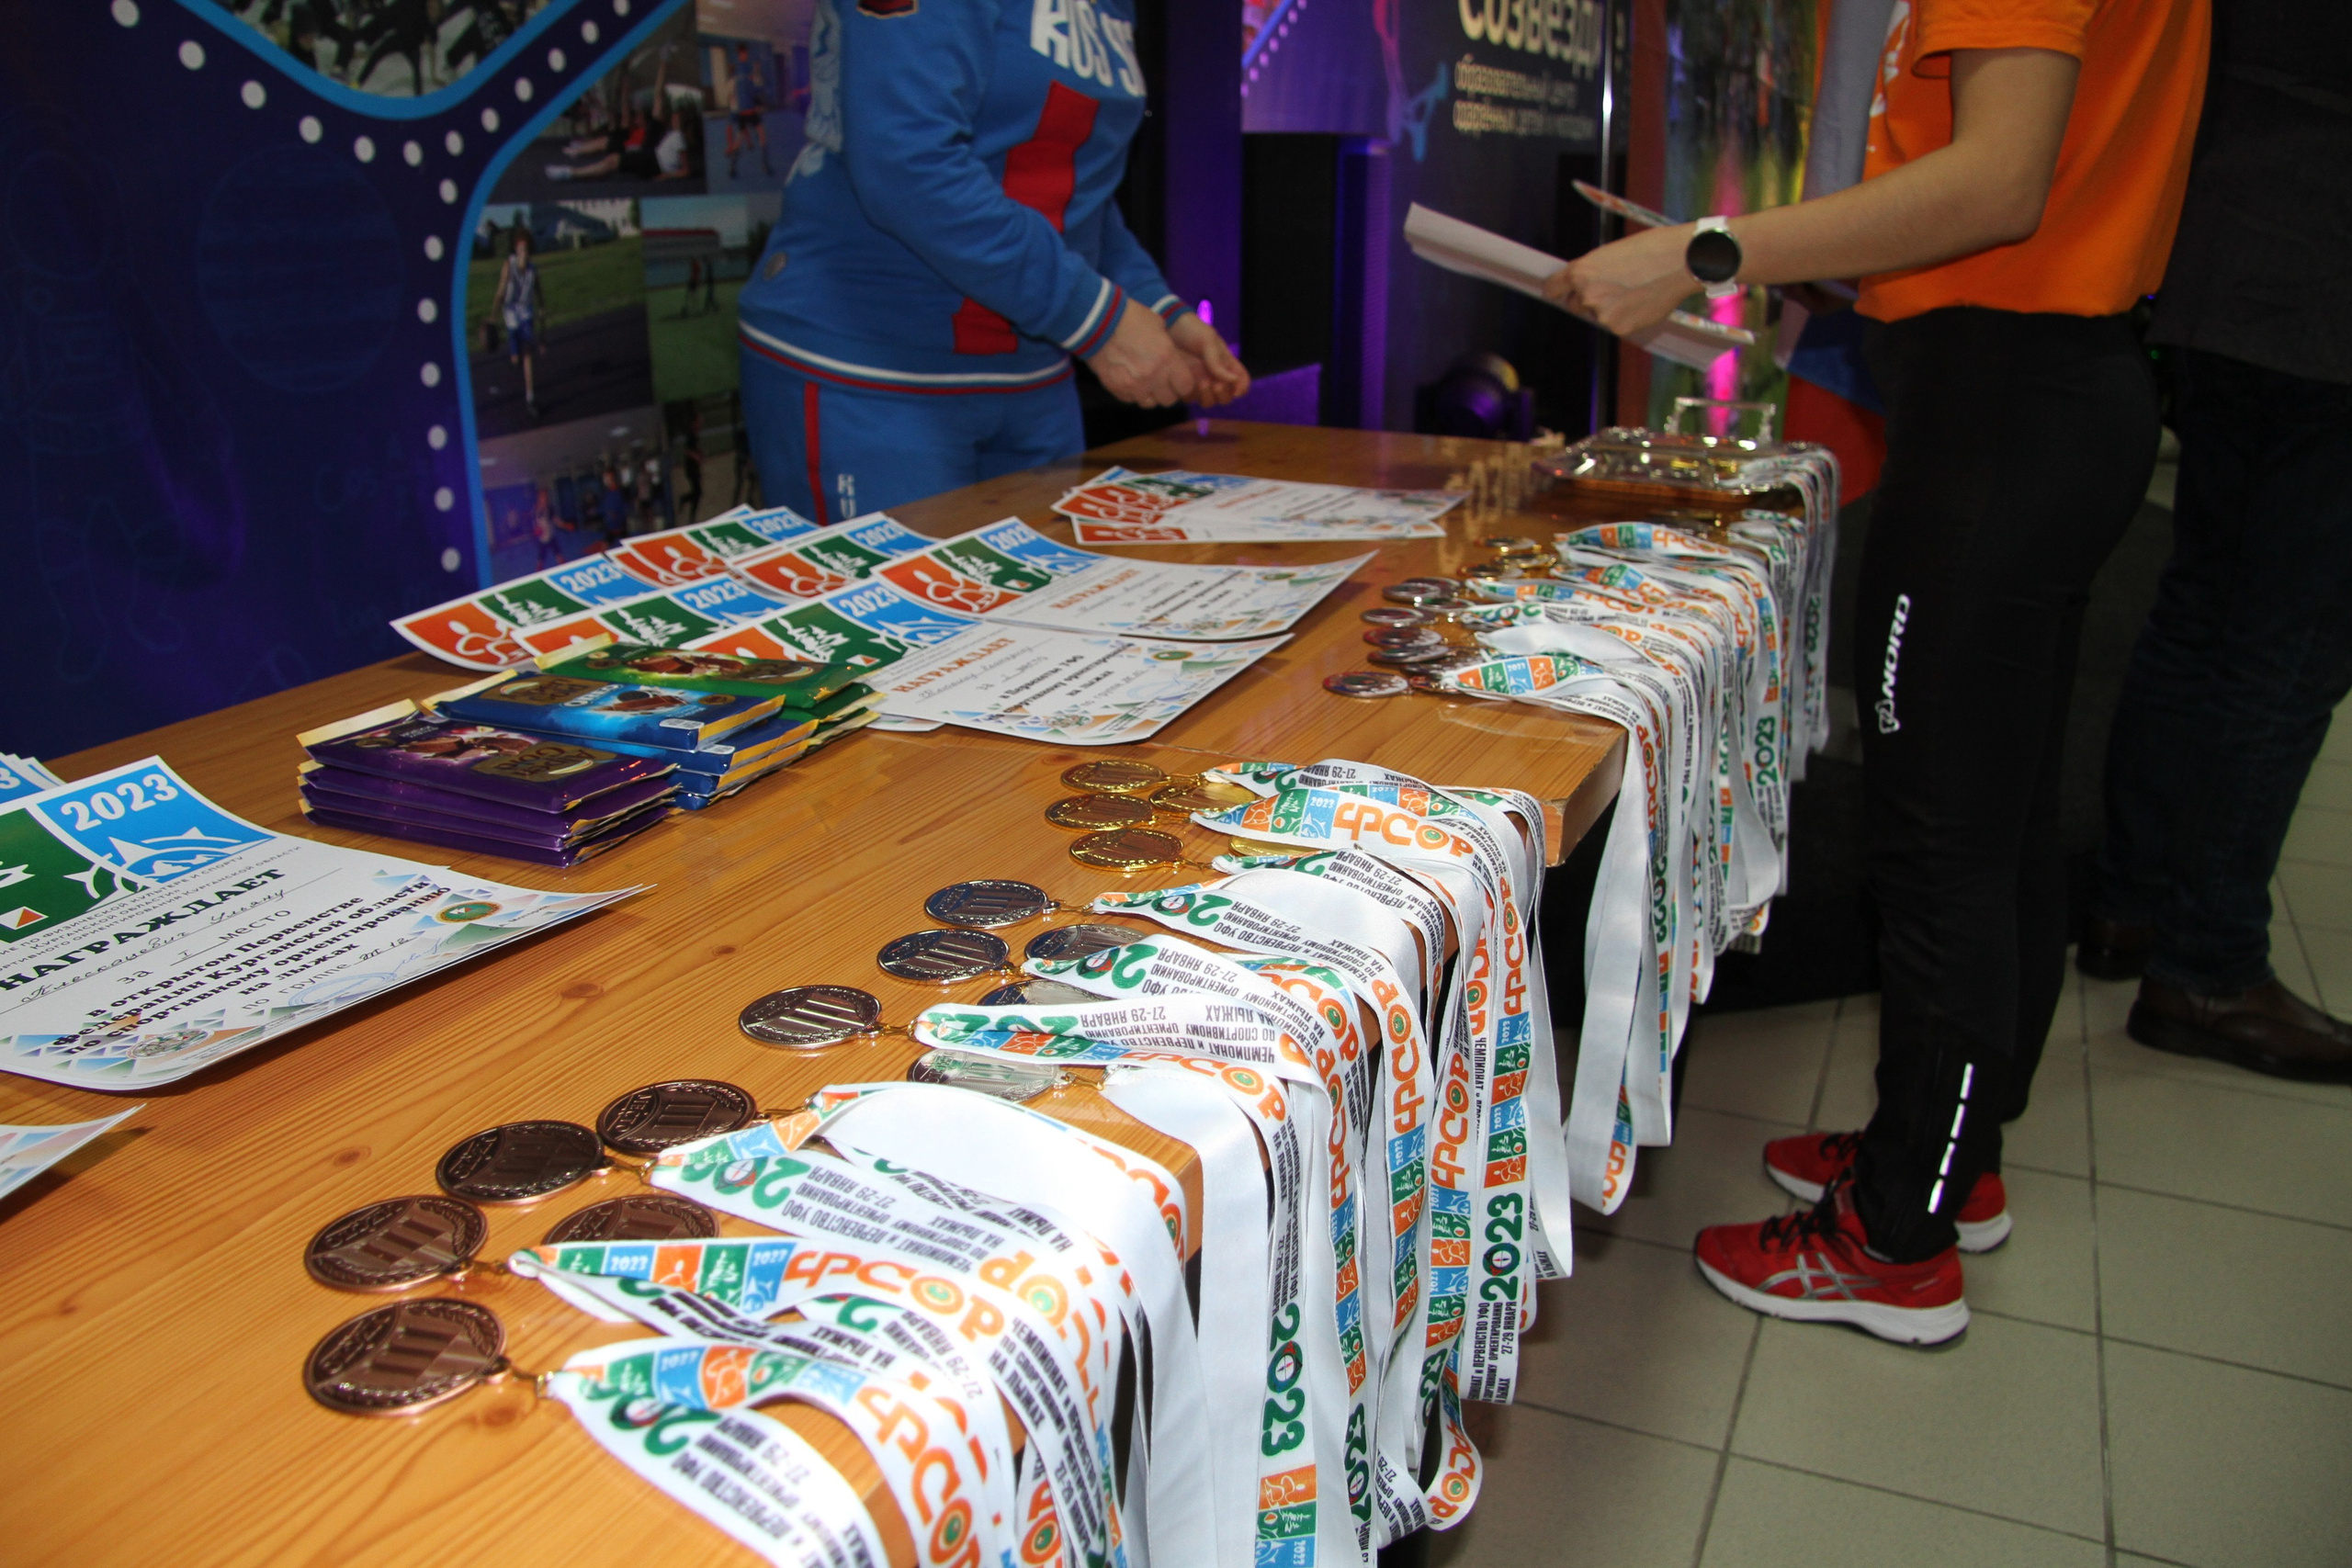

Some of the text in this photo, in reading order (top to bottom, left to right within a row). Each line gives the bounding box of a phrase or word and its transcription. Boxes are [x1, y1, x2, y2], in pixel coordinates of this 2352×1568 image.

[560, 563, 623, 593] 2023
[690, 575, 747, 610] 2023
[840, 588, 900, 617] 2023
[890, 637, 1016, 694] НАГРАЖДАЕТ
[1755, 716, 1781, 787] 2023
[61, 773, 178, 832] 2023
[1309, 796, 1335, 808] 2023
[1329, 862, 1404, 897] ОРИЕНТИРОВАНИЮ
[1336, 851, 1402, 886] 27-29 ЯНВАРЯ
[0, 869, 286, 990] НАГРАЖДАЕТ
[1223, 911, 1301, 942] ОРИЕНТИРОВАНИЮ
[1231, 900, 1302, 933] 27-29 ЯНВАРЯ
[52, 980, 208, 1046] федерации
[205, 919, 347, 980] Курганской
[348, 881, 432, 921] области
[85, 897, 365, 1019] в открытом Первенстве
[117, 969, 153, 985] за
[220, 908, 292, 942] место
[1213, 922, 1236, 937] УФО
[1238, 931, 1302, 954] ПЕРВЕНСТВО
[1310, 951, 1368, 984] ЧЕМПИОНАТ
[1329, 939, 1385, 973] НА ЛЫЖАХ
[63, 1039, 102, 1055] по
[106, 965, 268, 1037] спортивному
[274, 886, 452, 968] ориентированию
[239, 942, 360, 996] на лыжах
[1157, 947, 1238, 984] 27-29 ЯНВАРЯ
[1363, 965, 1376, 978] ПО
[242, 964, 351, 1010] по группе
[1141, 979, 1169, 996] УФО
[1150, 963, 1319, 1046] ПО СПОРТИВНОМУ ОРИЕНТИРОВАНИЮ
[1080, 1006, 1166, 1027] 27-29 ЯНВАРЯ
[1085, 1022, 1275, 1042] ПО СПОРТИВНОМУ ОРИЕНТИРОВАНИЮ
[1205, 1005, 1274, 1026] НА ЛЫЖАХ
[1272, 990, 1326, 1039] НА ЛЫЖАХ
[1122, 1035, 1195, 1050] ПЕРВЕНСТВО
[1209, 1042, 1275, 1064] ЧЕМПИОНАТ
[1474, 1037, 1487, 1090] ЧЕМПИОНАТ
[1287, 1115, 1300, 1185] ЧЕМПИОНАТ
[807, 1165, 857, 1190] ЯНВАРЯ
[781, 1200, 808, 1224] УФО
[796, 1182, 892, 1225] ОРИЕНТИРОВАНИЮ
[856, 1186, 896, 1209] 27-29
[809, 1210, 889, 1244] ПЕРВЕНСТВО
[890, 1219, 972, 1251] СПОРТИВНОМУ
[927, 1215, 985, 1241] ЛЫЖАХ
[982, 1233, 1005, 1249] НА
[609, 1255, 648, 1272] 2023
[894, 1238, 973, 1274] ЧЕМПИОНАТ
[969, 1247, 989, 1261] ПО
[1480, 1192, 1523, 1302] 2023
[1478, 1303, 1490, 1319] УФО
[1501, 1302, 1517, 1355] 27-29 ЯНВАРЯ
[871, 1350, 896, 1370] НА
[1012, 1316, 1069, 1404] ЧЕМПИОНАТ
[1473, 1320, 1487, 1369] ПЕРВЕНСТВО
[989, 1349, 1046, 1431] НА ЛЫЖАХ
[1261, 1303, 1306, 1457] 2023
[1293, 1540, 1306, 1565] 2023
